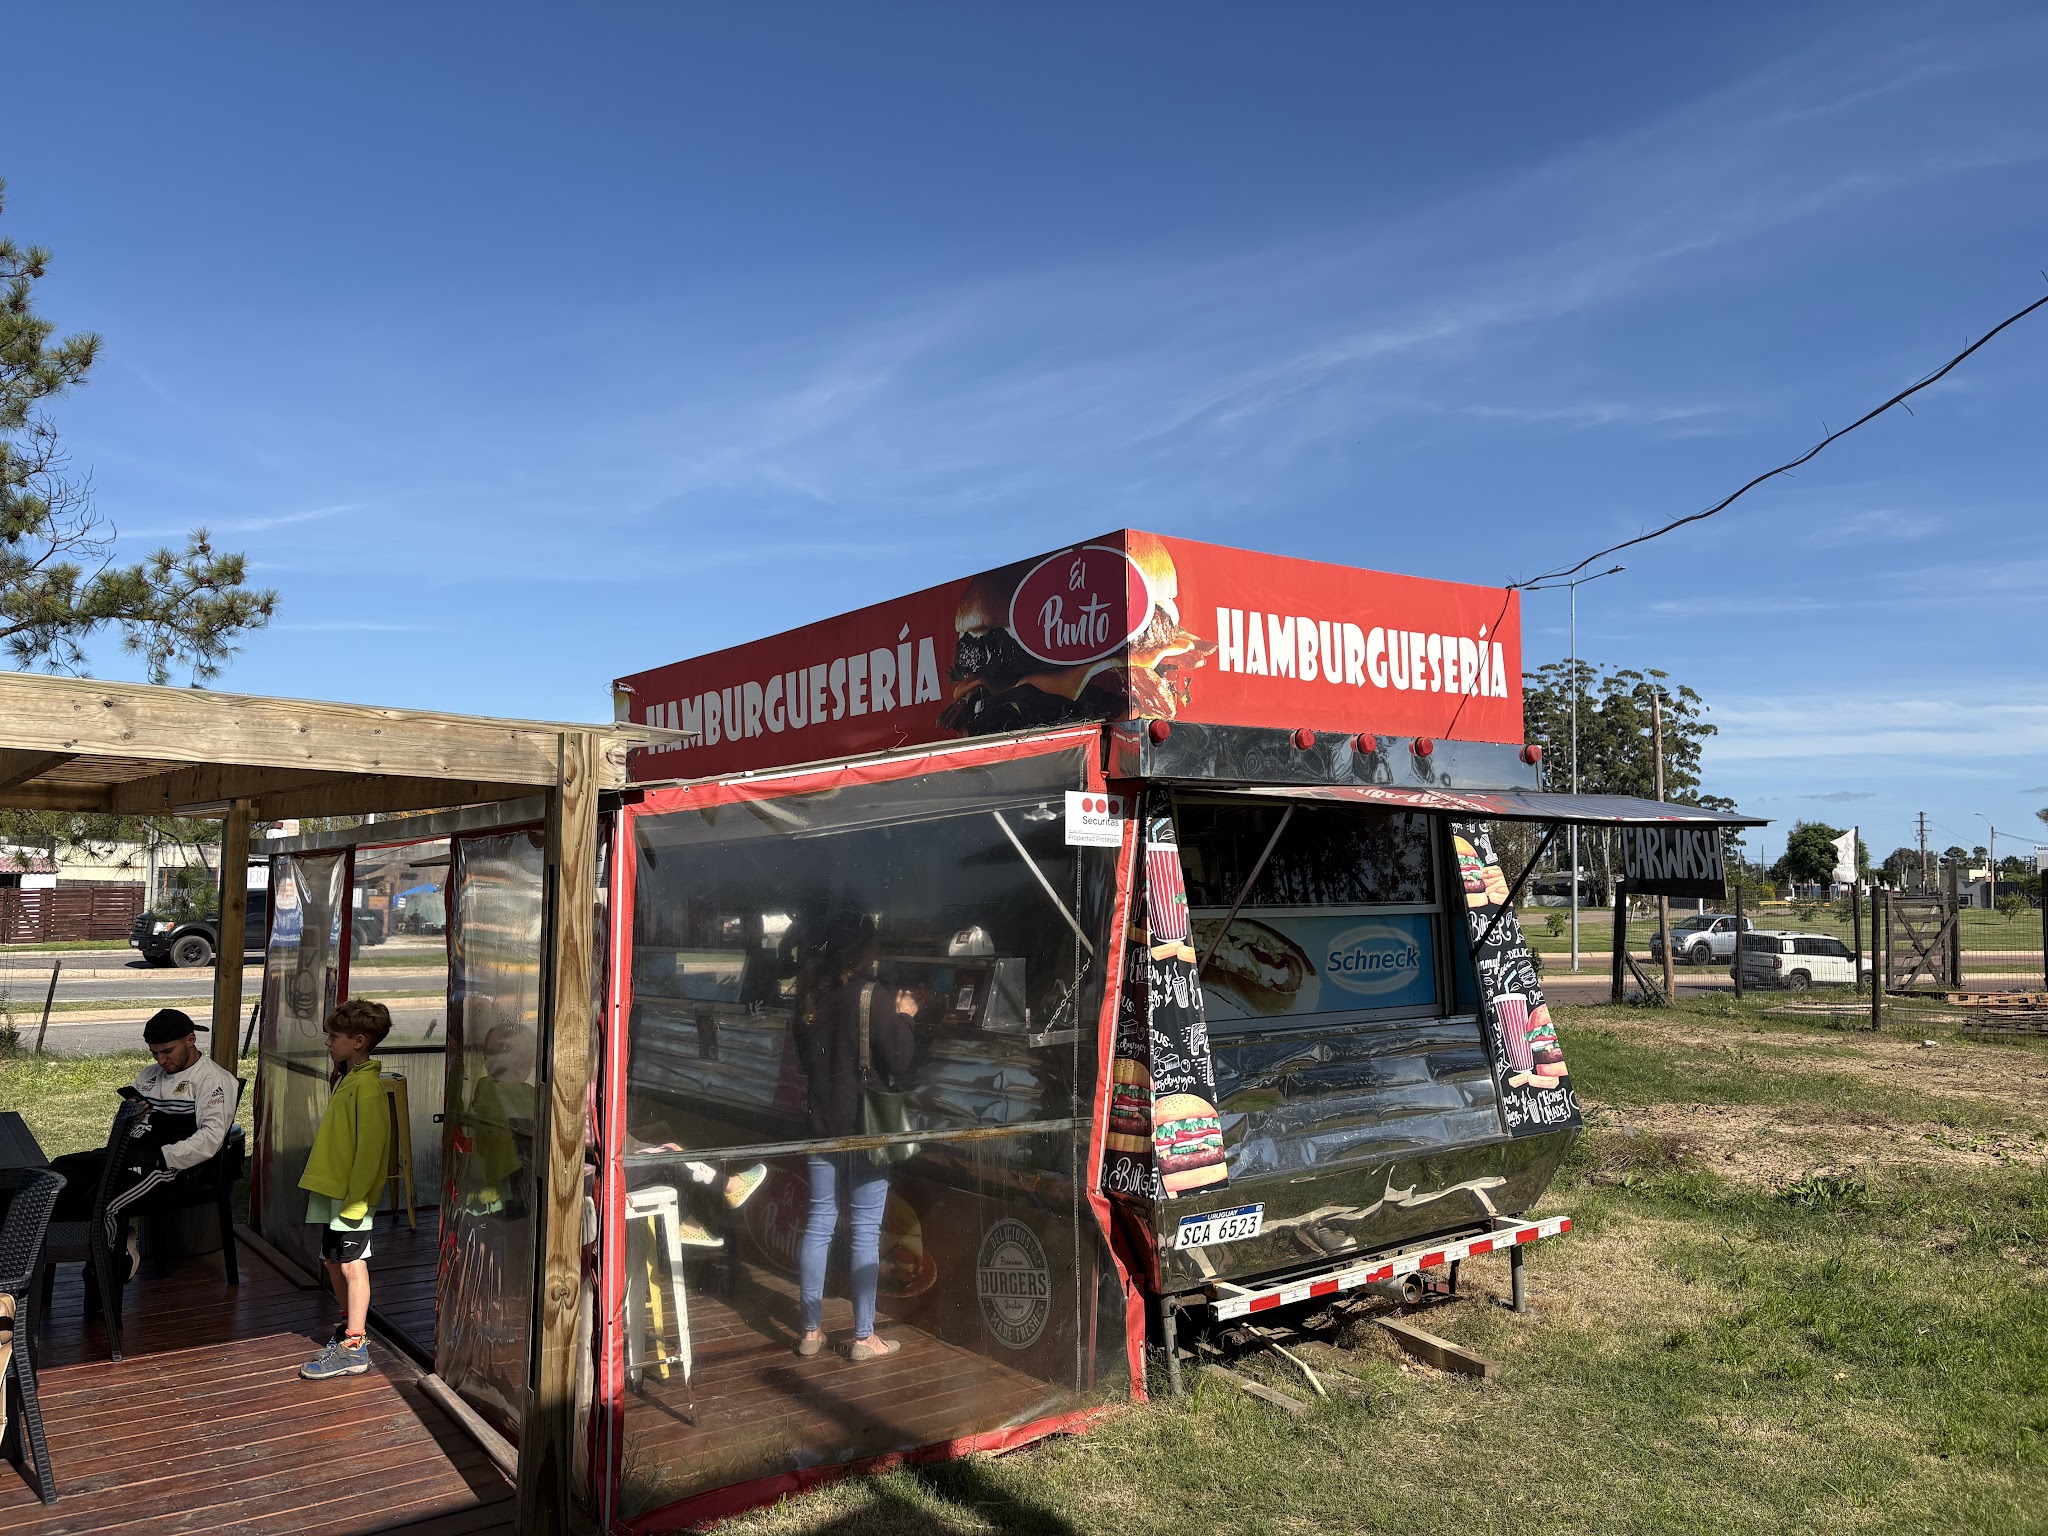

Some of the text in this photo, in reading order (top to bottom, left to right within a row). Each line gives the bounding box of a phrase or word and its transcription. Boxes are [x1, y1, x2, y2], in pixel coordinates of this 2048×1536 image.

[1068, 556, 1086, 591] El
[1037, 592, 1111, 650] Punto
[1216, 623, 1509, 699] HAMBURGUESERÍA
[645, 622, 942, 756] HAMBURGUESERÍA
[1082, 815, 1119, 827] Securitas
[1068, 834, 1095, 842] Propiedad
[1622, 826, 1724, 881] CARWASH
[1327, 947, 1419, 973] Schneck
[1541, 1089, 1563, 1105] HOME
[1543, 1103, 1567, 1122] MADE
[1207, 1208, 1239, 1220] URUGUAY
[761, 1201, 803, 1263] Punt
[989, 1225, 1032, 1249] DELICIOUS
[1181, 1215, 1258, 1246] SCA 6523
[980, 1271, 1047, 1296] BURGERS
[990, 1311, 1040, 1341] MADE FRESH
